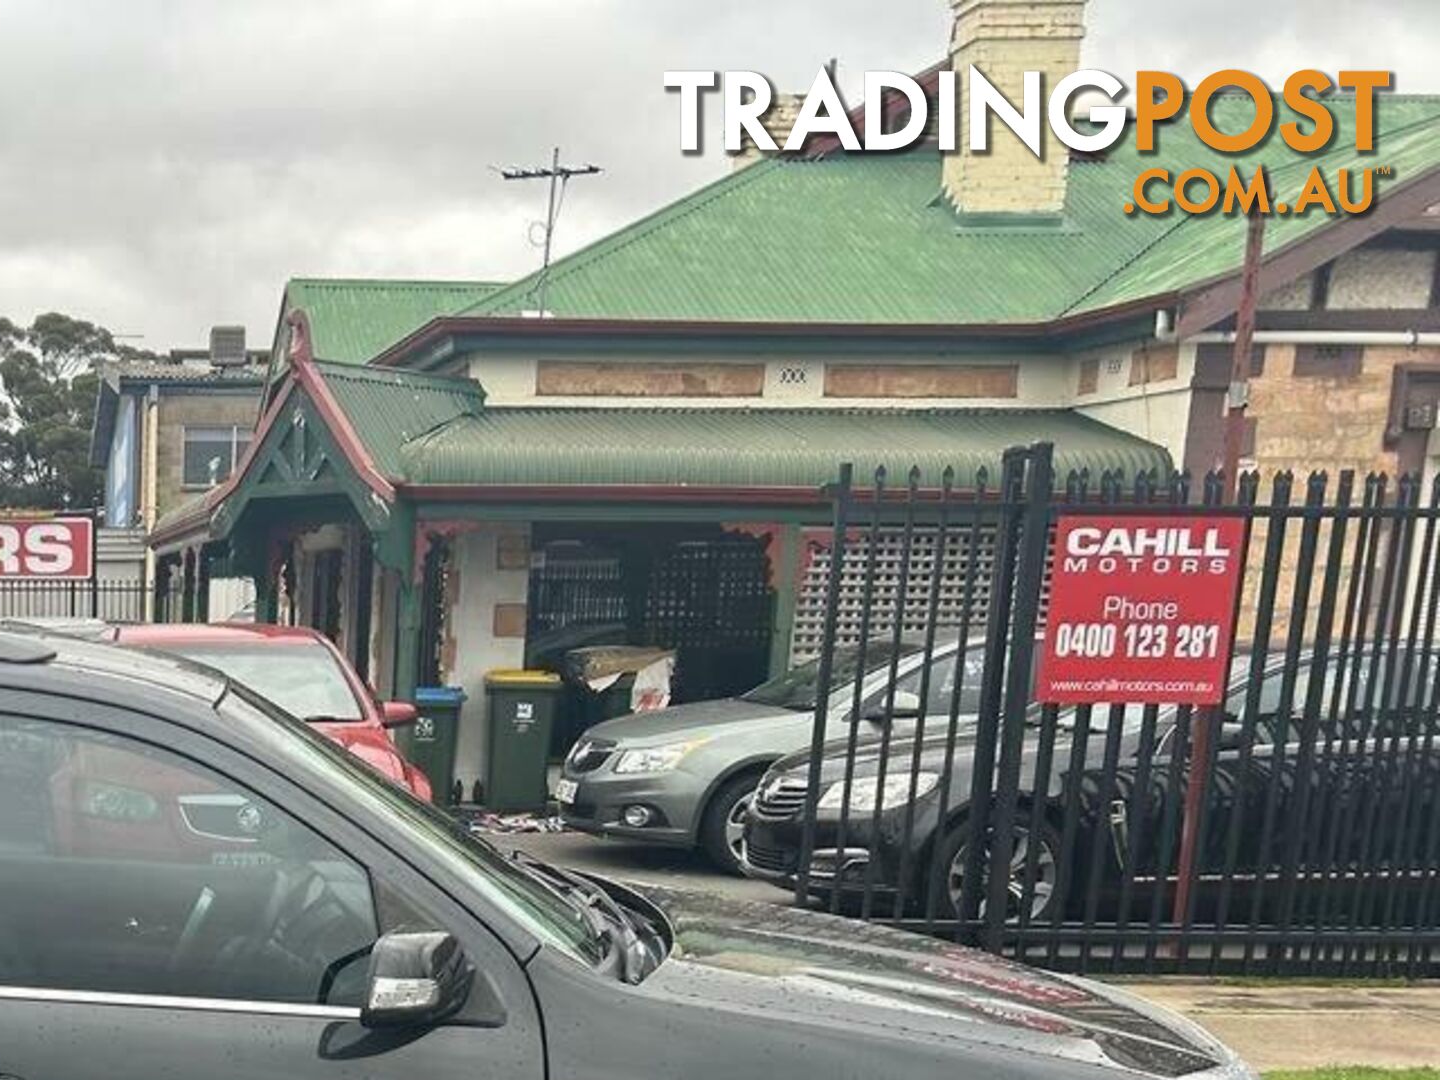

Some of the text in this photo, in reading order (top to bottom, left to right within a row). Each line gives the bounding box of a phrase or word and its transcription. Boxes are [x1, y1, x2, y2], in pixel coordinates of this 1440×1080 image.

[1067, 527, 1229, 557] CAHILL
[1063, 557, 1226, 574] MOTORS
[1103, 595, 1178, 621] Phone
[1055, 623, 1220, 659] 0400 123 281
[1050, 680, 1213, 695] www.cahillmotors.com.au
